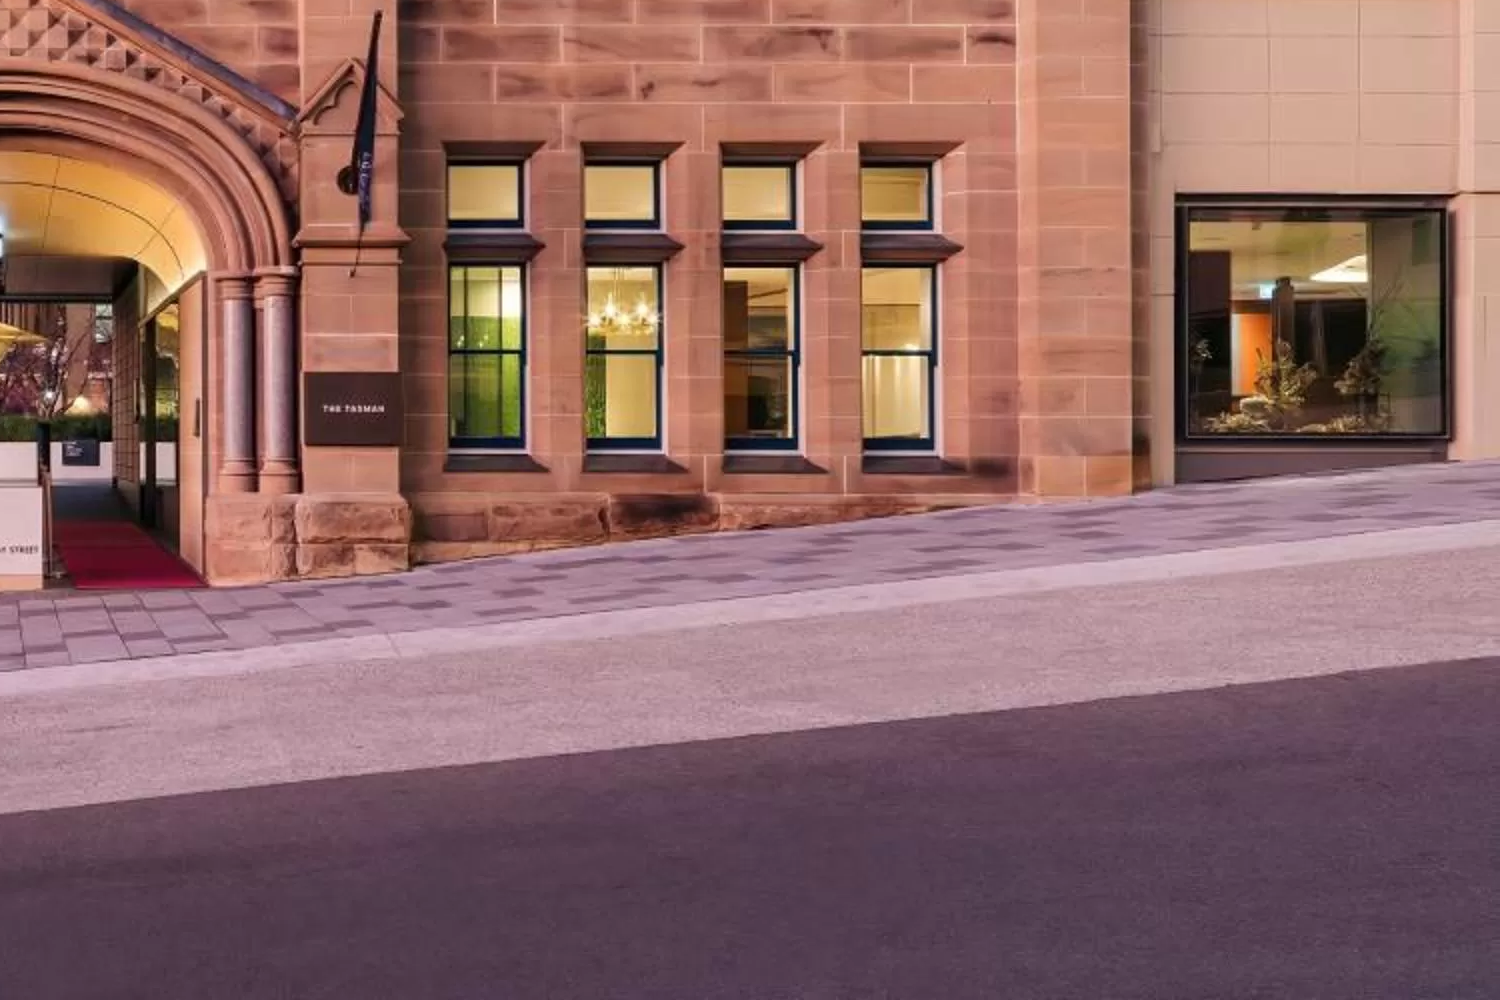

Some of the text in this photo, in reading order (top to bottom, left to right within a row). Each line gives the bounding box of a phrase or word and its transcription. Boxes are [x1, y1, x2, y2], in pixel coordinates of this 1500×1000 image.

[323, 404, 385, 413] THE TASMAN
[9, 545, 39, 554] STREET
